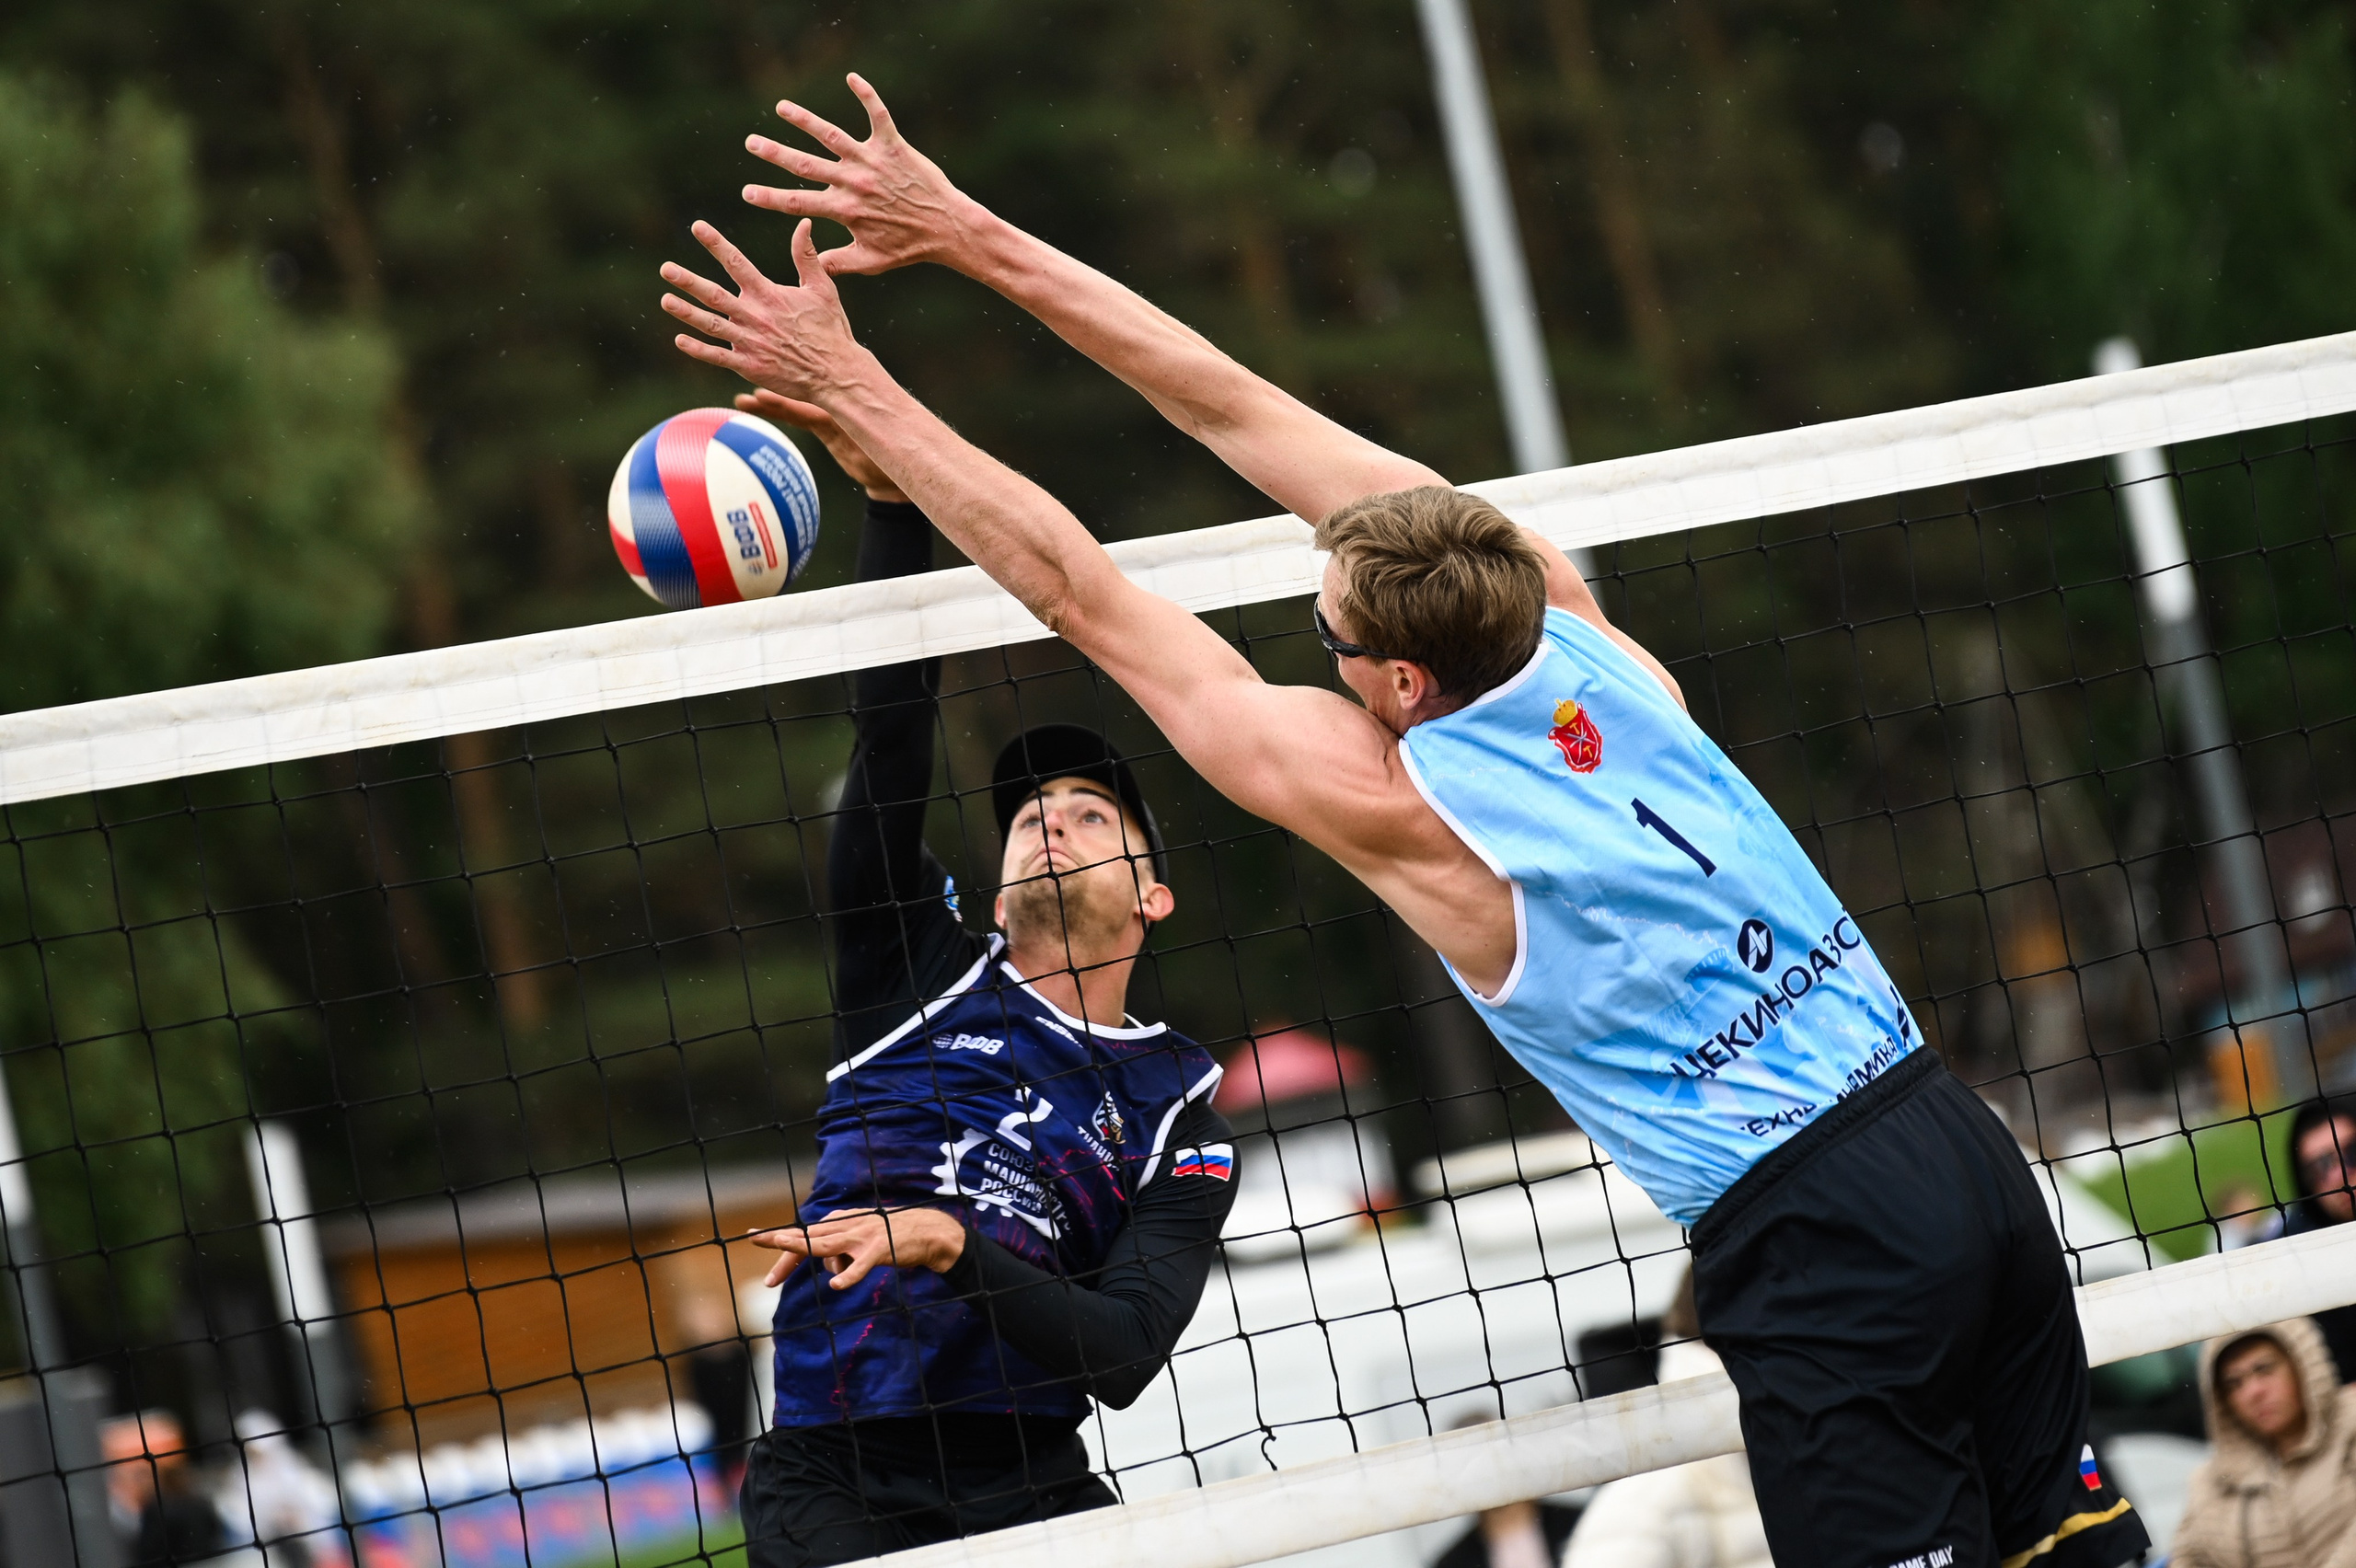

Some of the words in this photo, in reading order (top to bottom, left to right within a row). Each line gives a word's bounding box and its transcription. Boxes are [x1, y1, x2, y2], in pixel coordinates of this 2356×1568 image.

[1630, 797, 1717, 878] 1
[950, 1032, 1005, 1055] ВФВ
[995, 1086, 1054, 1152] 2
[987, 1143, 1034, 1172] СОЮЗ
[1928, 1544, 1954, 1568] DAY
